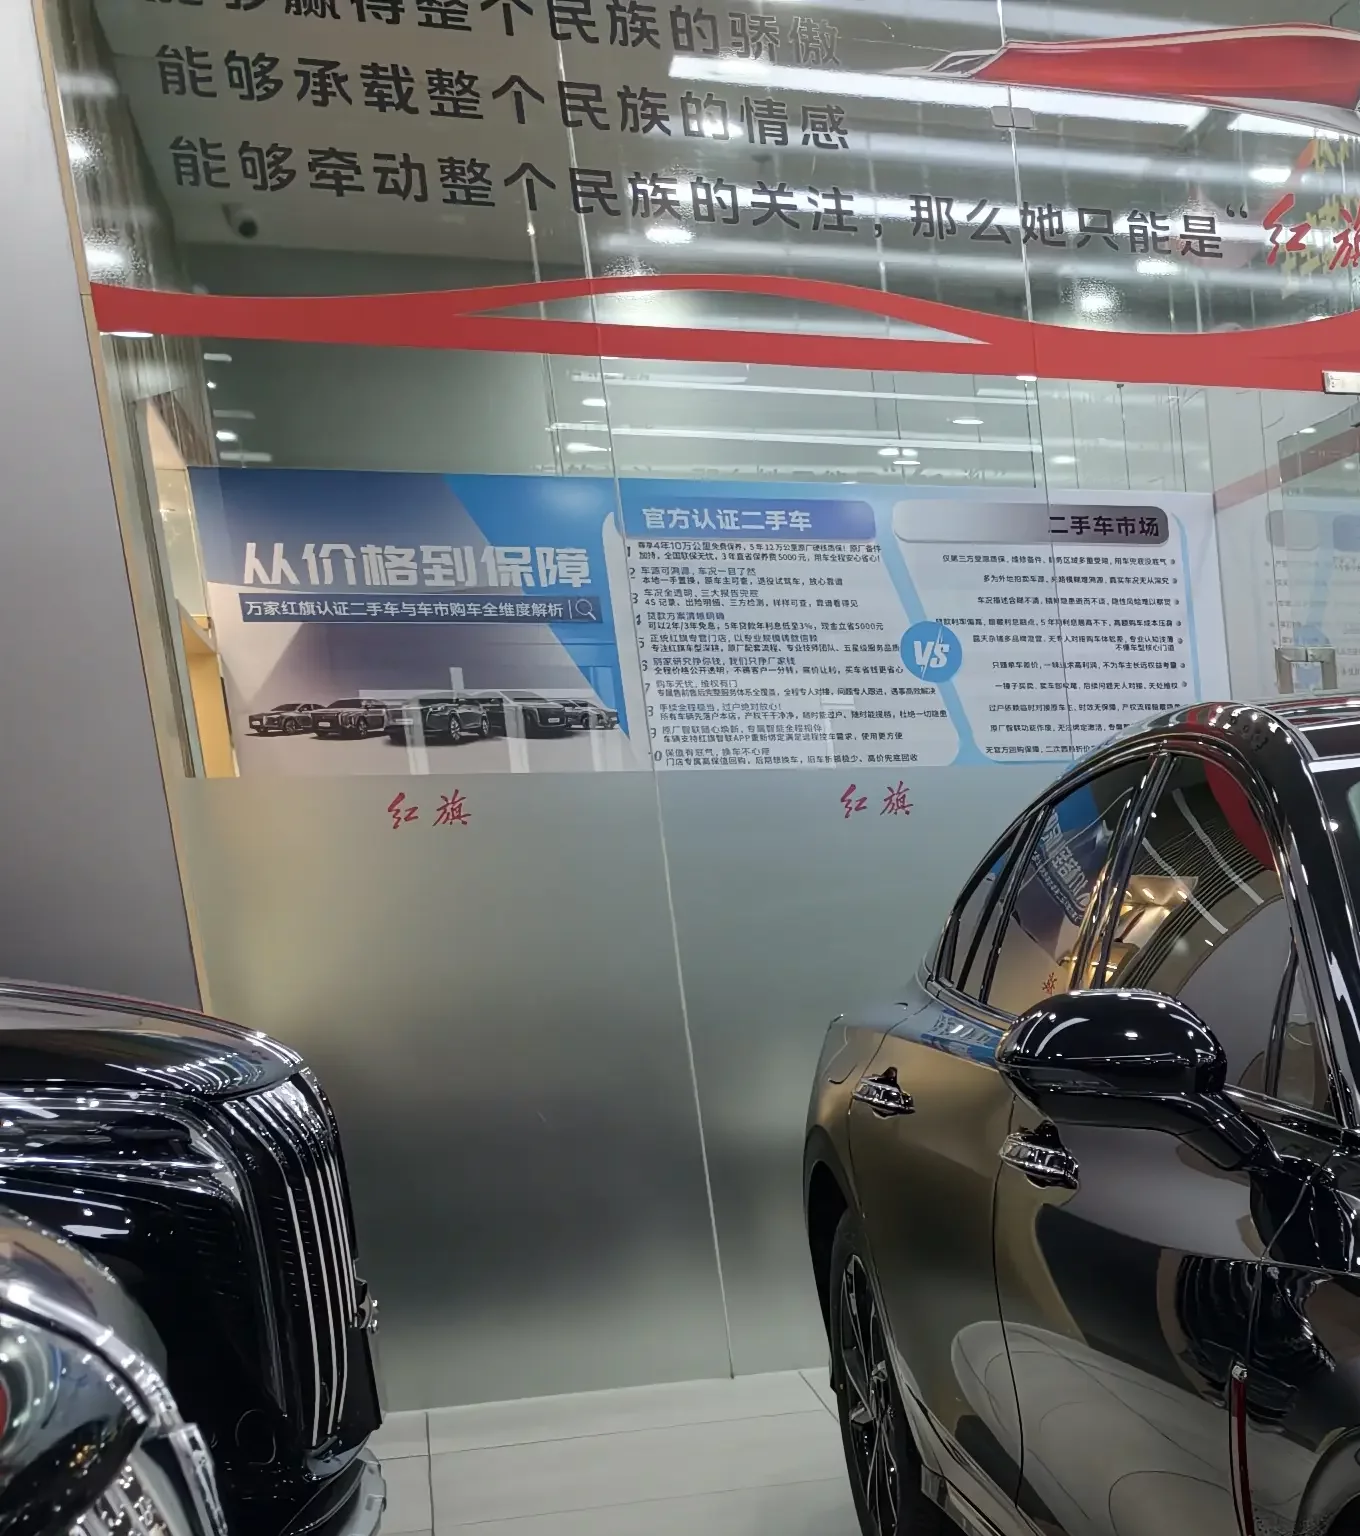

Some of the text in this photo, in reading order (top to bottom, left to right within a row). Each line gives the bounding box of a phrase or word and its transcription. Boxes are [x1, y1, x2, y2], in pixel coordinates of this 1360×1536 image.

[156, 44, 850, 150] 能够承载整个民族的情感
[641, 507, 813, 532] 官方认证二手车
[1048, 515, 1160, 538] 二手车市场
[243, 542, 592, 588] 从价格到保障
[913, 640, 949, 669] VS
[387, 789, 472, 829] 红旗
[840, 780, 914, 819] 红旗
